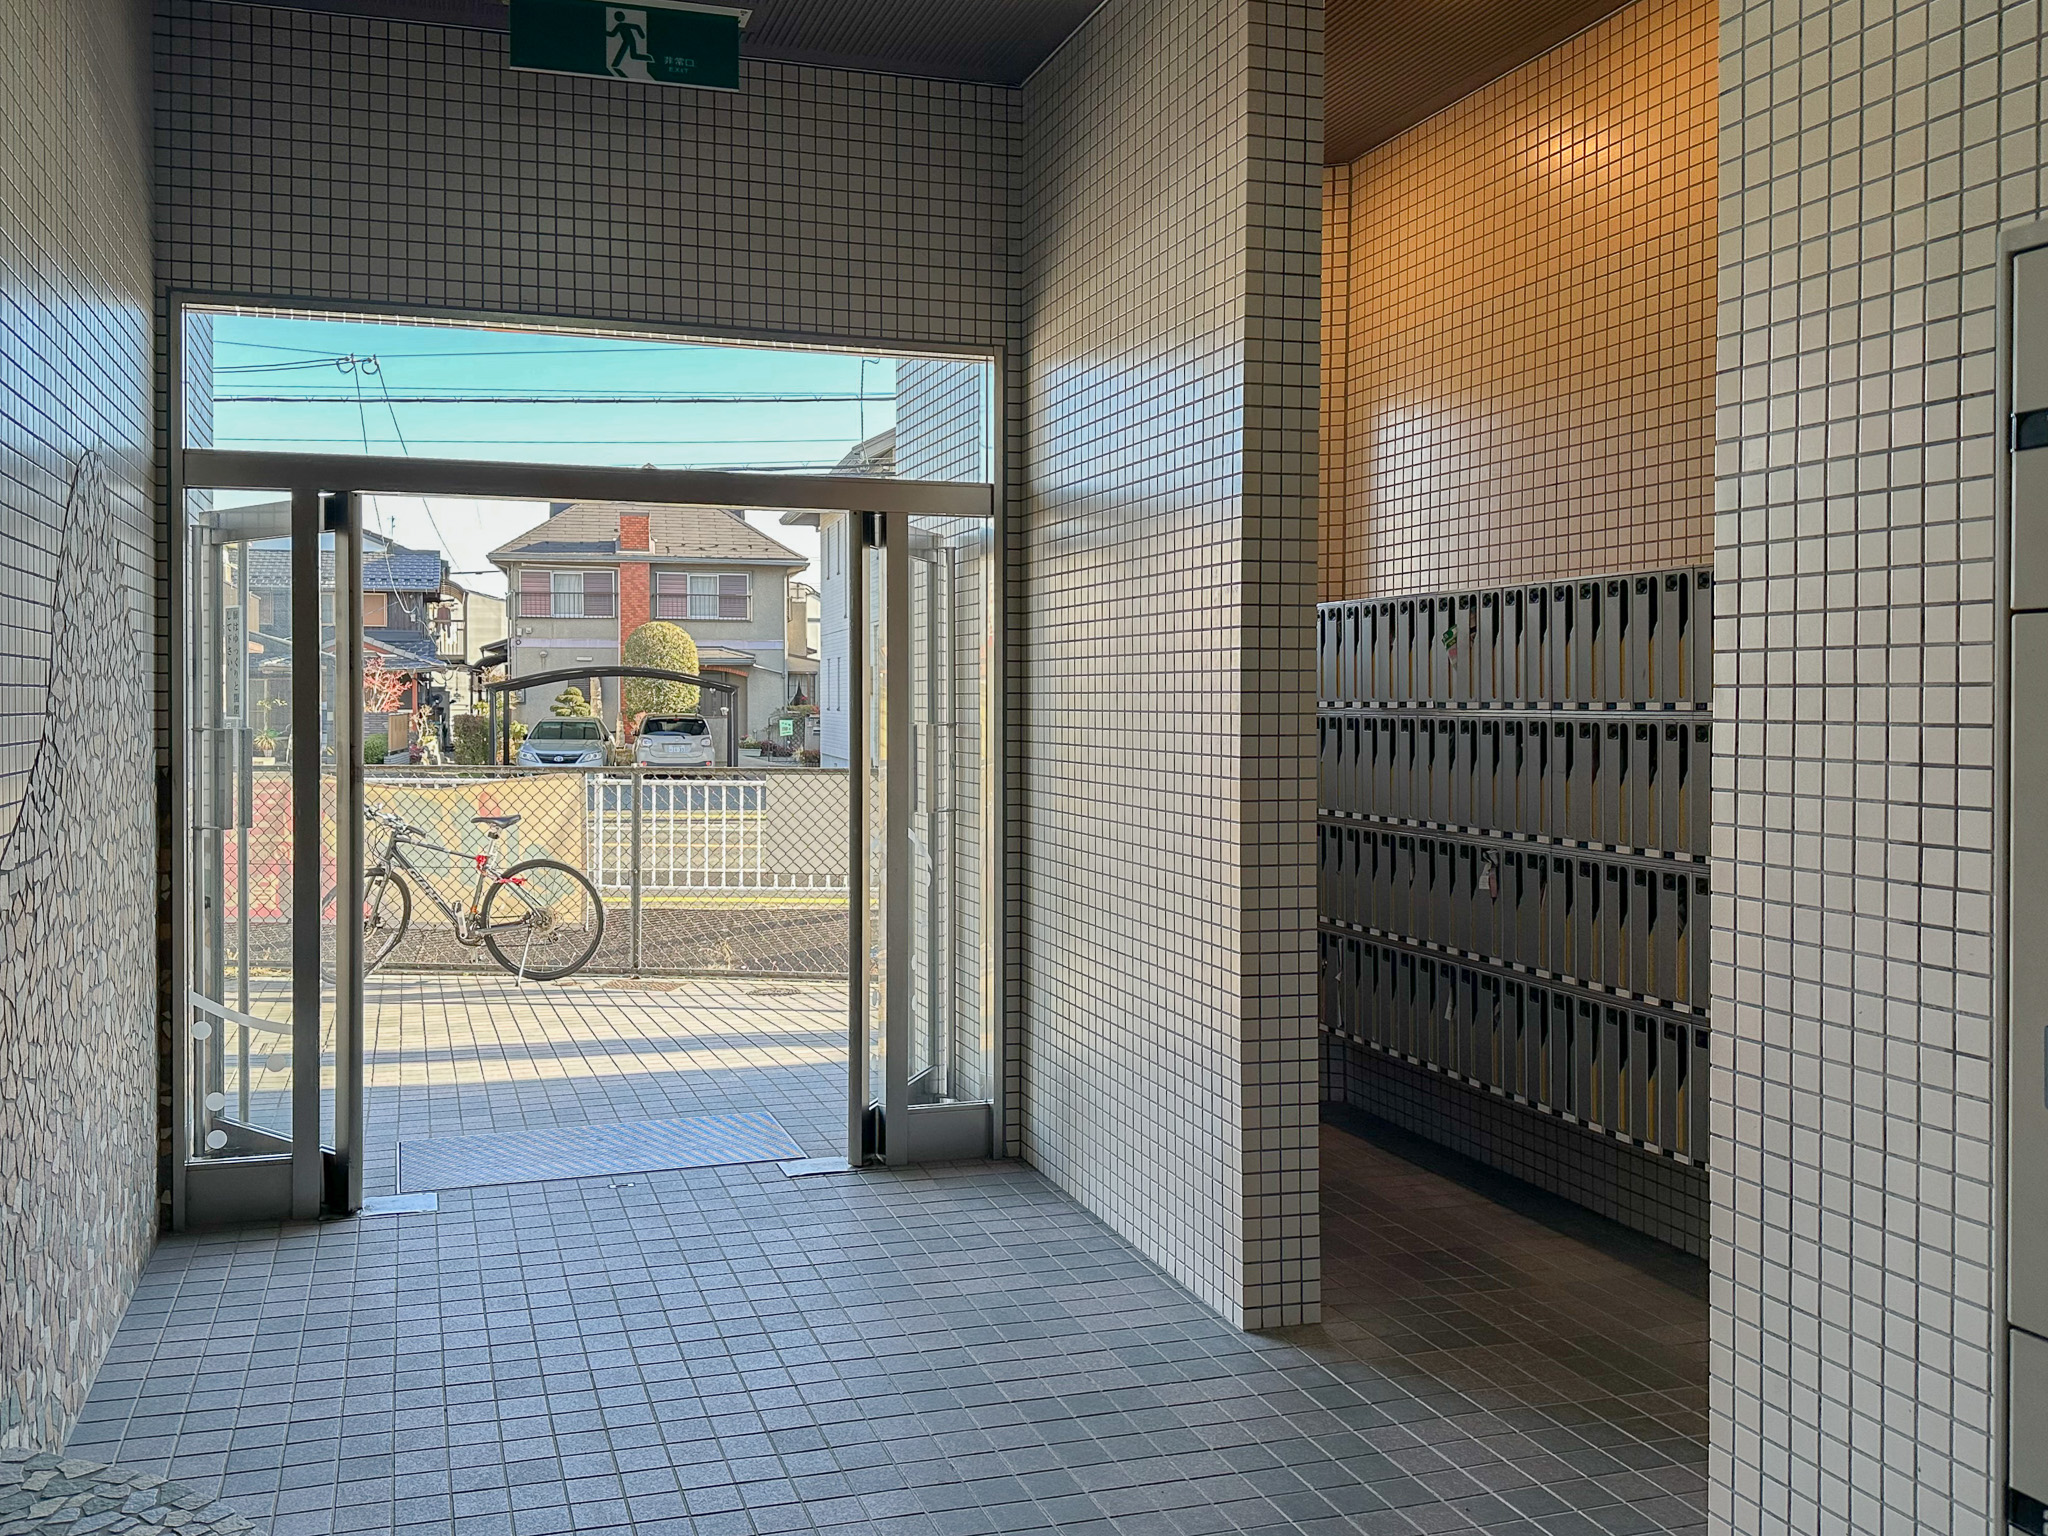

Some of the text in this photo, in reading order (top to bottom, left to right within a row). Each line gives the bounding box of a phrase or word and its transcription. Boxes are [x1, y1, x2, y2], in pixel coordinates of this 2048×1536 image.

[664, 56, 695, 67] 非常口
[668, 66, 689, 74] EXIT
